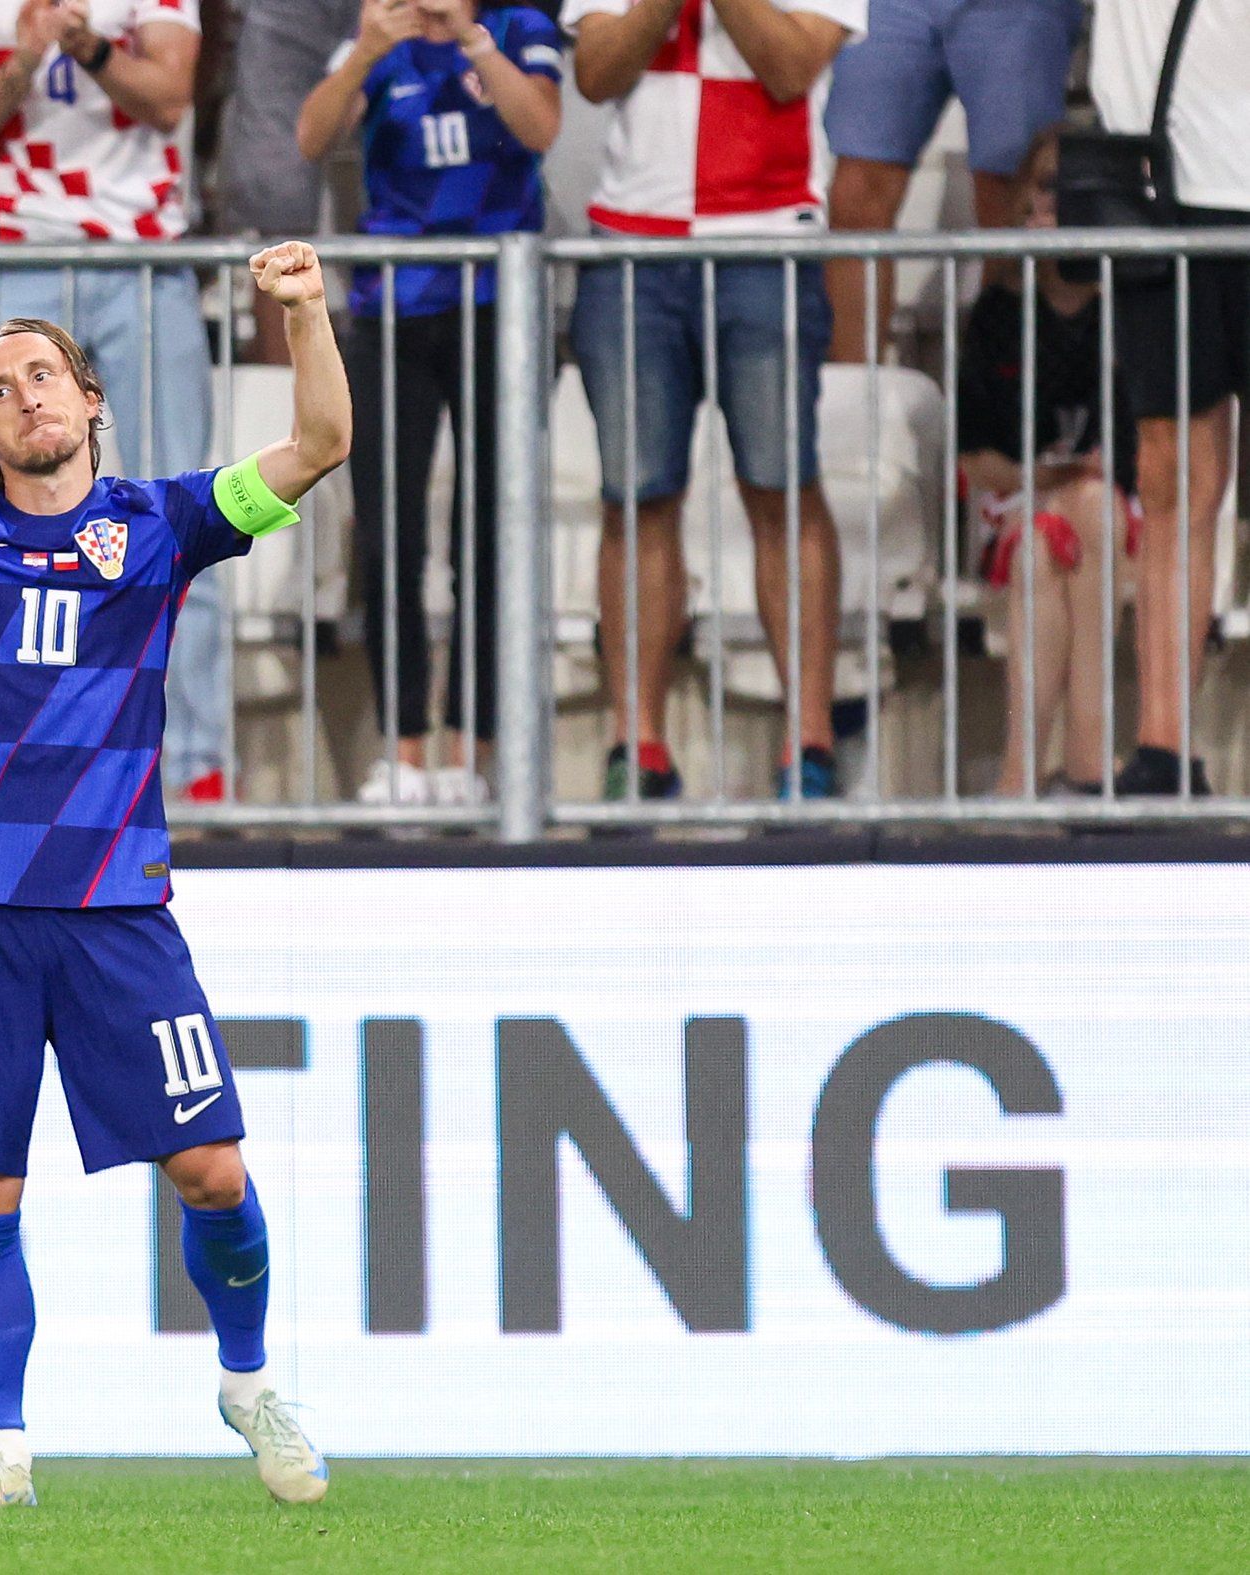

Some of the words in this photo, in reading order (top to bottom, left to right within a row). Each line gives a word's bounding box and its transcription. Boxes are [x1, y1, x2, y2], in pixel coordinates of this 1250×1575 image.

[421, 112, 470, 167] 10
[17, 587, 81, 666] 10
[151, 1013, 223, 1096] 10
